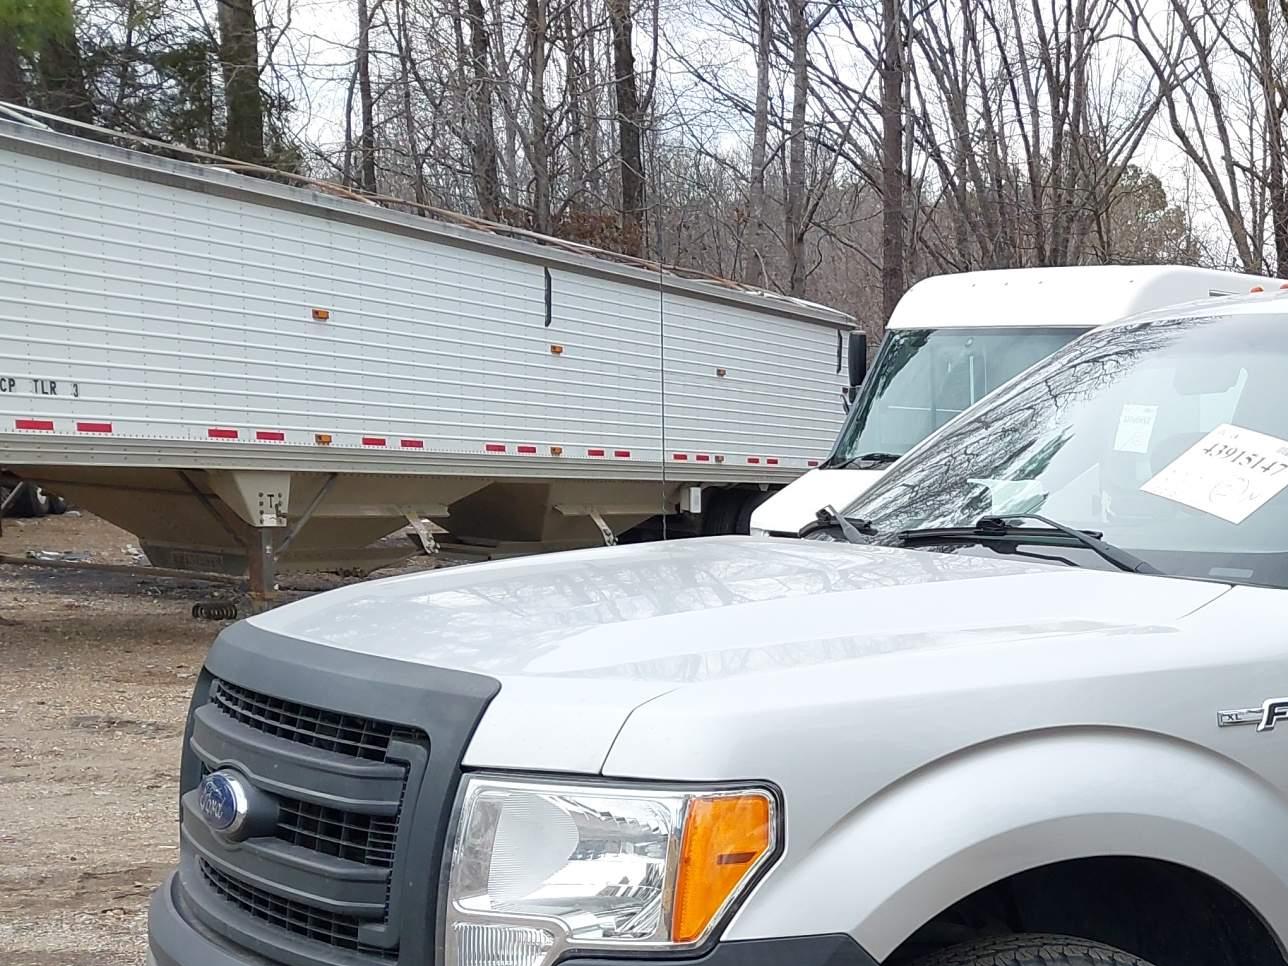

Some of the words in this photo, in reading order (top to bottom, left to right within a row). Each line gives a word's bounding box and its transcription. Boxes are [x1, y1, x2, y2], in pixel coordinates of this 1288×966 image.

[33, 379, 57, 396] TLR
[72, 383, 79, 398] 3
[1203, 443, 1288, 476] 43915147
[199, 781, 226, 818] Ford
